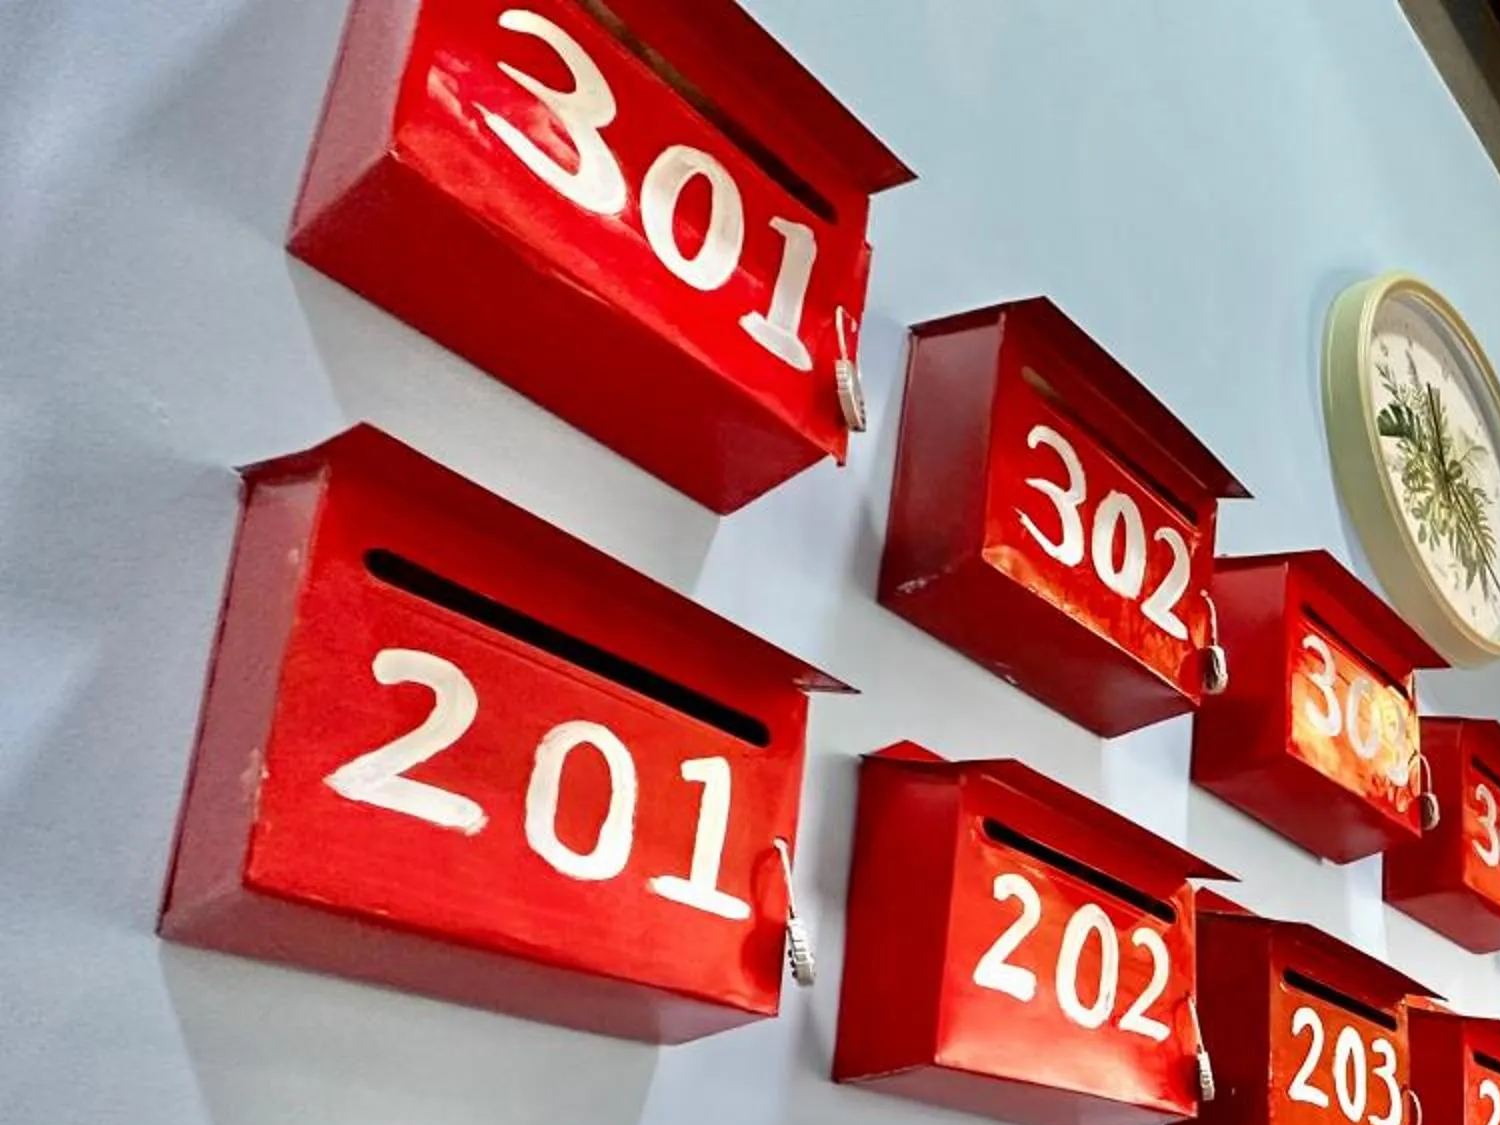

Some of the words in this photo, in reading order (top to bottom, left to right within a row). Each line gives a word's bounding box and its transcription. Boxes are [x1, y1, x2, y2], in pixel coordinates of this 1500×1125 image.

[472, 8, 818, 372] 301
[1014, 424, 1192, 641] 302
[323, 647, 751, 920] 201
[972, 873, 1173, 1043] 202
